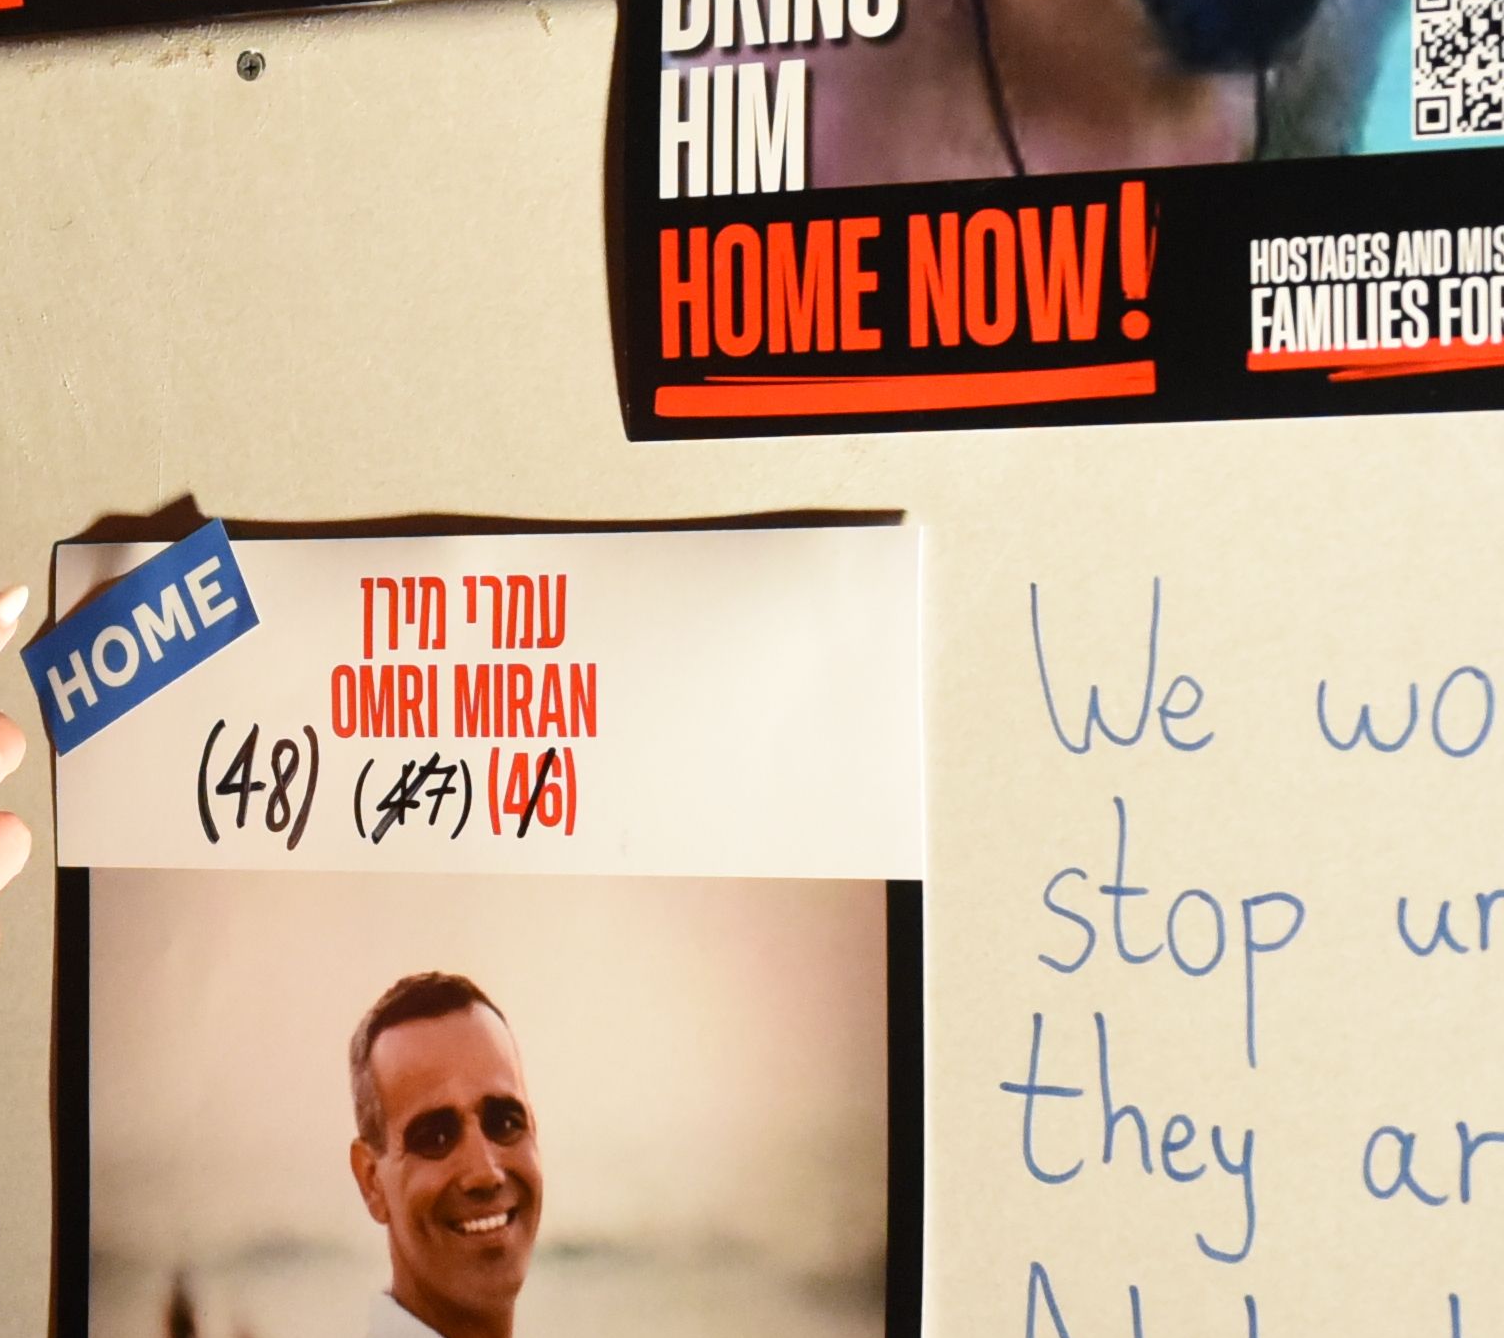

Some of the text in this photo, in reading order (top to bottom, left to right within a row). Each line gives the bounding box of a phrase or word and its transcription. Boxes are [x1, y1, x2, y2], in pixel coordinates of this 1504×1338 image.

[658, 59, 807, 200] HIM
[659, 179, 1160, 360] HOME NOW!
[1250, 229, 1390, 288] HOSTAGES
[1393, 226, 1453, 278] AND
[1250, 280, 1430, 355] FAMILIES
[46, 554, 238, 723] HOME
[359, 573, 569, 660] עמרי מירן
[1029, 574, 1216, 754] We
[330, 662, 597, 739] OMRI MIRAN
[194, 718, 320, 851] (48)
[1037, 795, 1306, 1069] stop
[998, 1011, 1258, 1264] they
